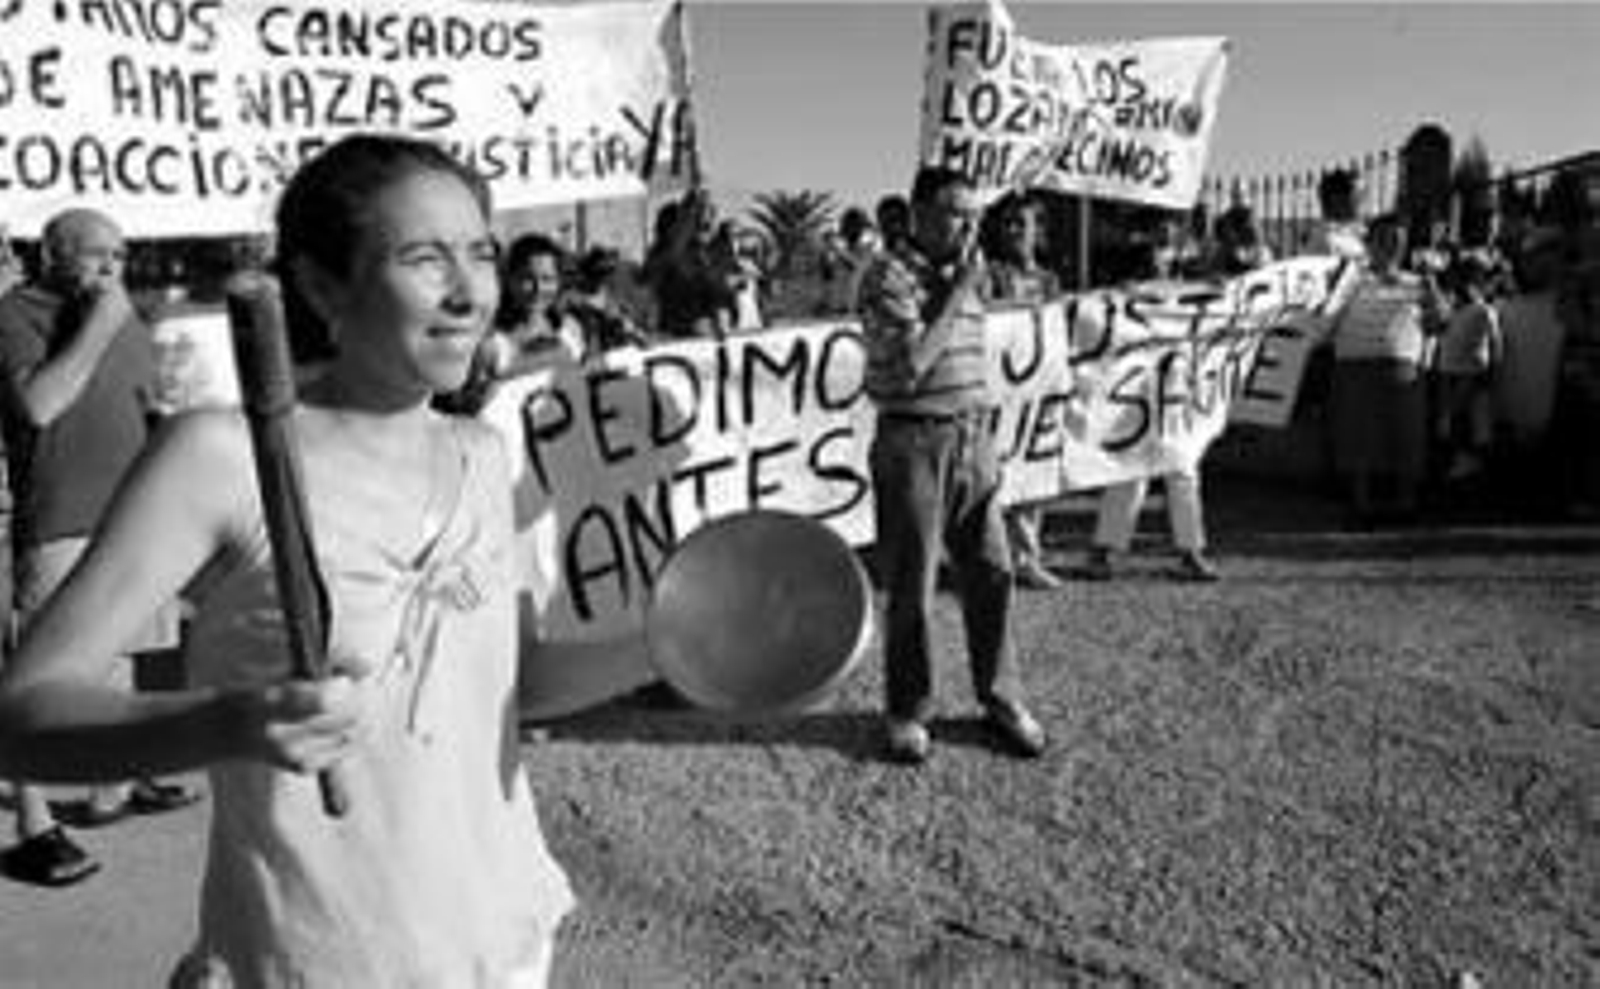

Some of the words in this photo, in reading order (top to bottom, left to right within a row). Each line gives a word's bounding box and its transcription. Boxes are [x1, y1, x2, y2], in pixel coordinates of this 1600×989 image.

[257, 6, 542, 62] CANSADOS
[109, 55, 456, 130] AMENAZAS
[618, 99, 702, 182] YA
[1052, 131, 1171, 189] ECINOS
[523, 330, 869, 496] PEDIMO
[564, 427, 869, 622] ANTES
[988, 391, 1078, 463] UE
